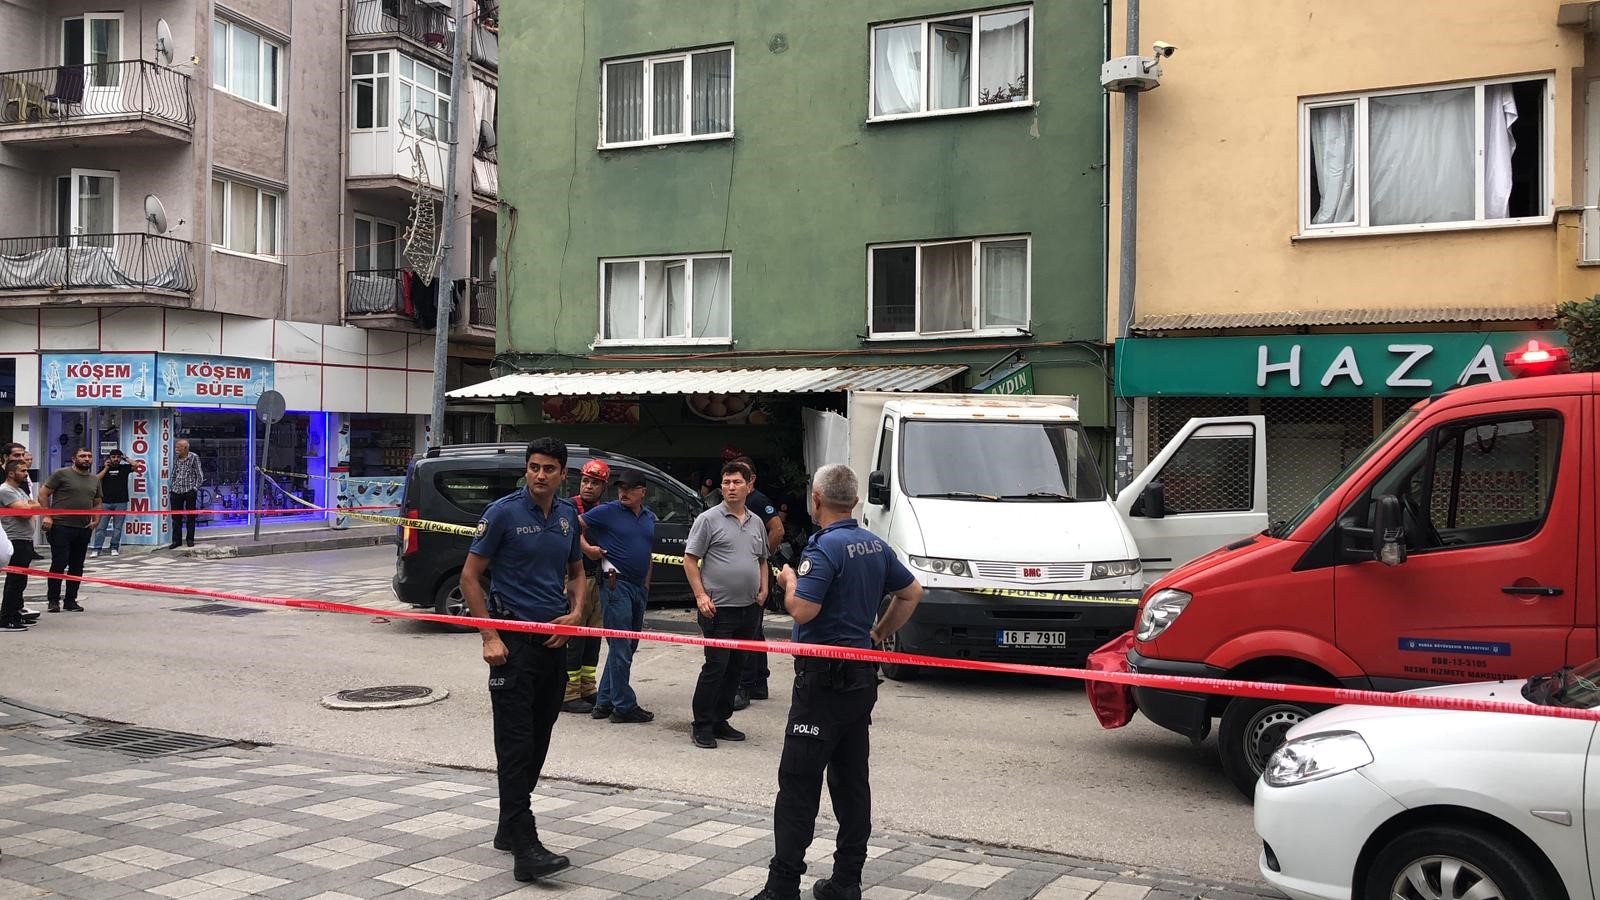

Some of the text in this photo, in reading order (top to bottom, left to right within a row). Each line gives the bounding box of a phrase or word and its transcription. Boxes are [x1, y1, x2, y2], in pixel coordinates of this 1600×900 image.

[66, 361, 131, 381] KÖŞEM
[186, 361, 251, 381] KÖŞEM
[76, 381, 123, 398] BÜFE
[196, 381, 244, 397] BÜFE
[161, 419, 169, 479] KÖŞEM
[130, 420, 149, 513] KÖŞEM
[125, 519, 152, 535] BÜFE
[516, 525, 542, 535] POLİS
[846, 540, 883, 559] POLİS
[1023, 567, 1042, 578] BMC
[1004, 631, 1065, 645] 16 F 7910
[793, 723, 820, 736] POLİS
